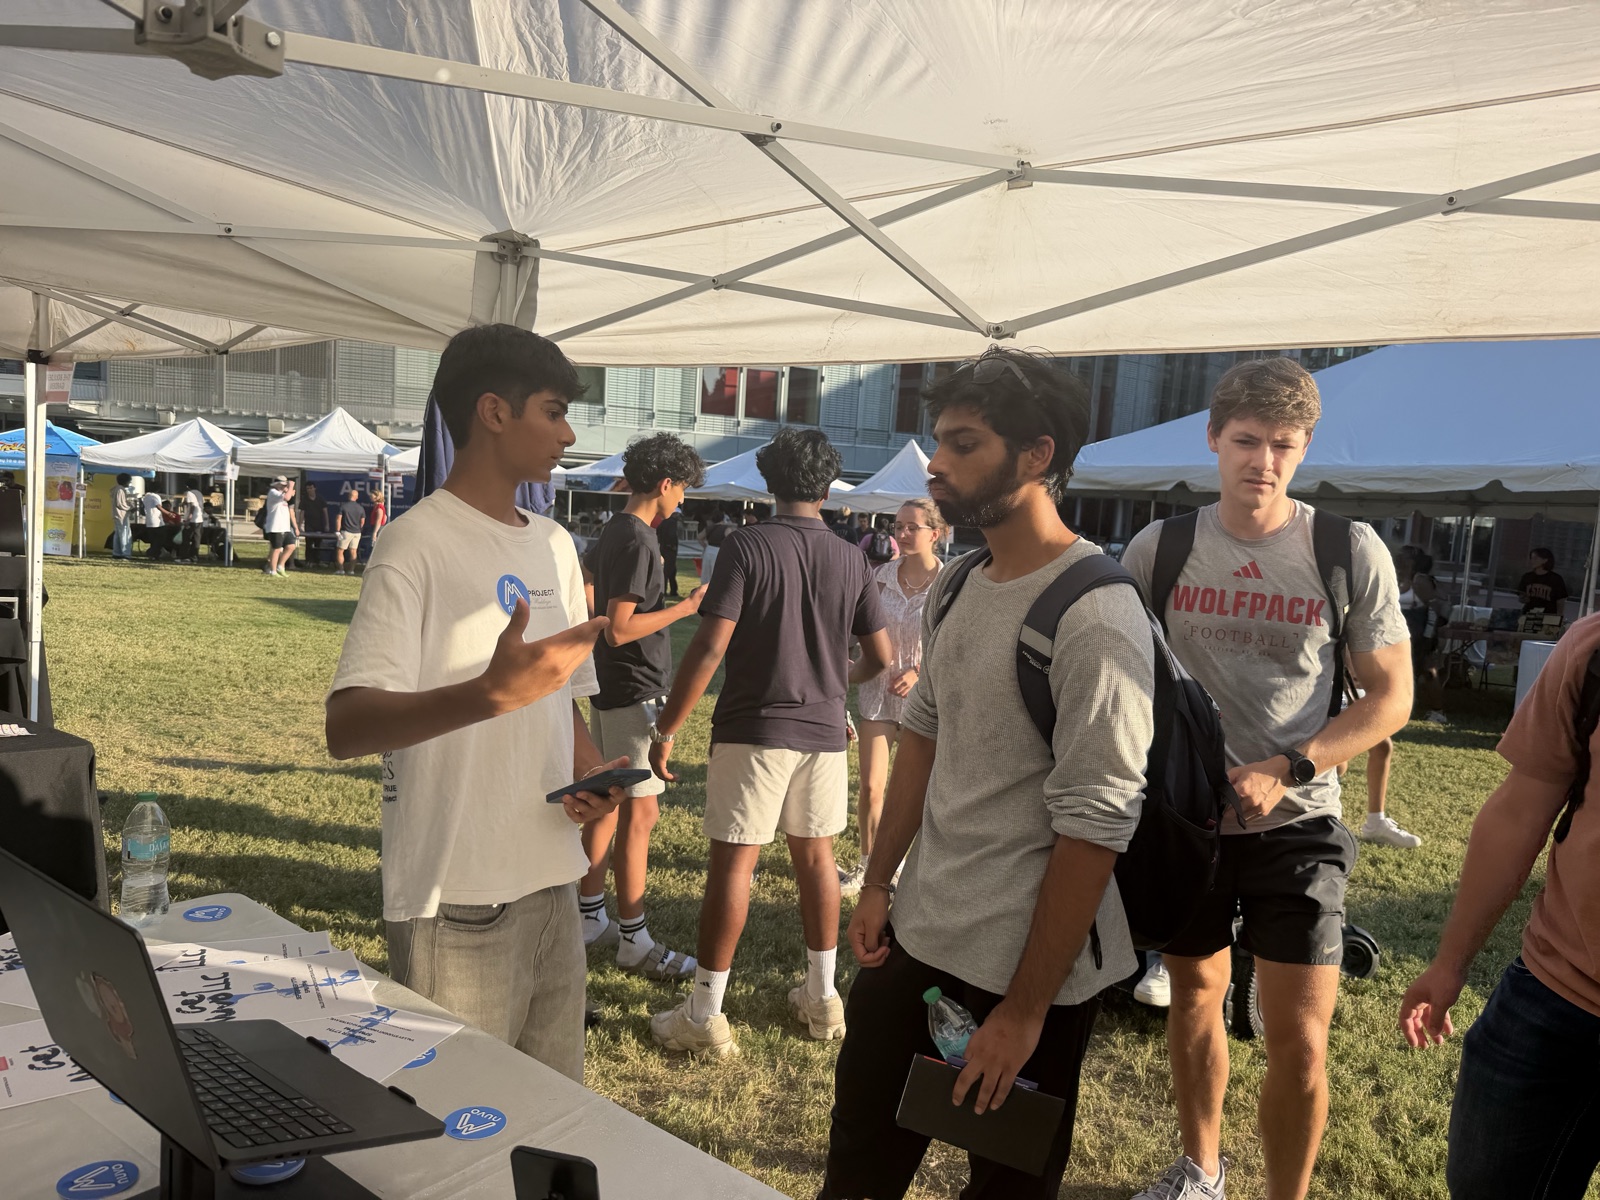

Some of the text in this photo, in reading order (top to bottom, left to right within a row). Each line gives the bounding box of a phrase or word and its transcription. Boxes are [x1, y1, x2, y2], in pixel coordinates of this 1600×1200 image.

[528, 589, 555, 597] PROJECT
[1173, 585, 1326, 626] WOLFPACK
[1190, 625, 1290, 648] FOOTBALL
[149, 841, 169, 852] DASA
[471, 1108, 502, 1122] nuvo
[112, 1163, 129, 1185] nuvo
